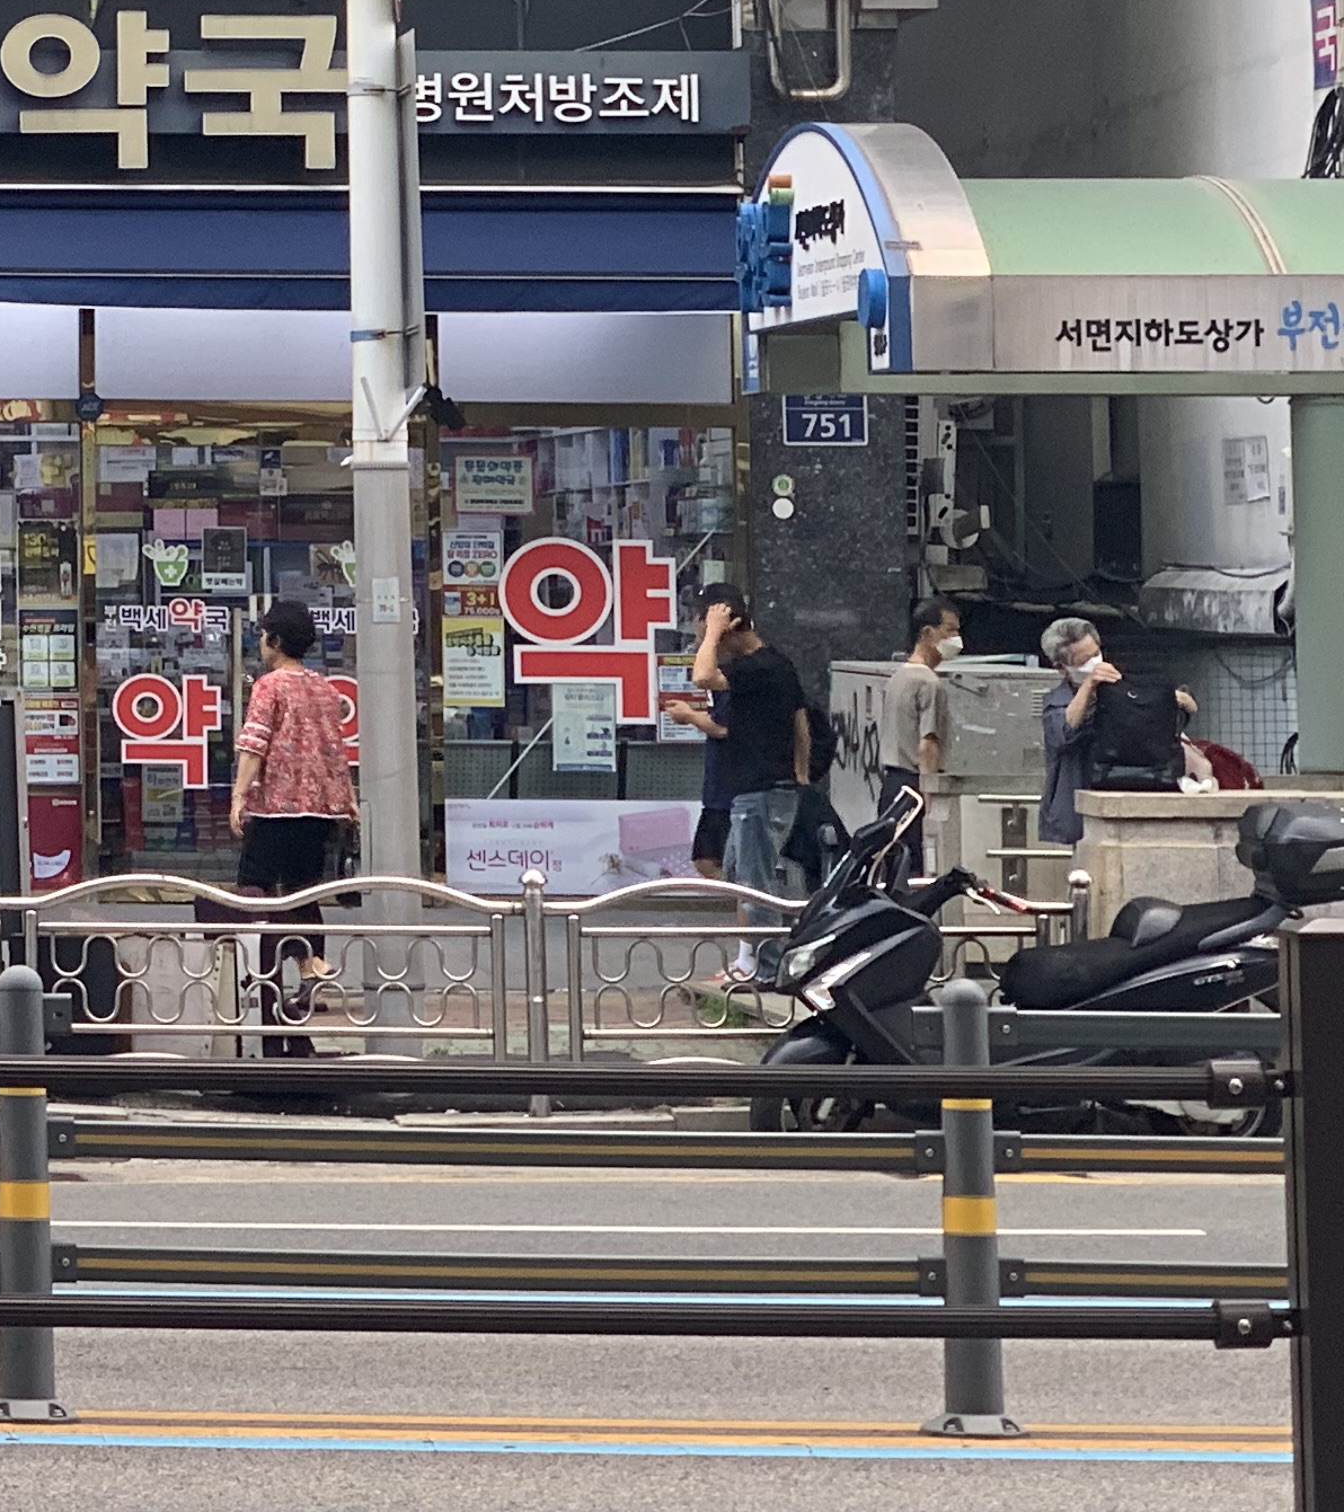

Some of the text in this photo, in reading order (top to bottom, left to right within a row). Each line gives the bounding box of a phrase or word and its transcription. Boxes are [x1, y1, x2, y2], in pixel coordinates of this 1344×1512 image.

[411, 72, 700, 125] 병원처방조제
[1055, 300, 1341, 353] 서면지하도상가 부전
[802, 414, 850, 438] 751
[119, 598, 230, 633] 백세약국
[499, 535, 677, 726] 약
[112, 673, 223, 789] 약
[467, 849, 550, 872] 센스데이
